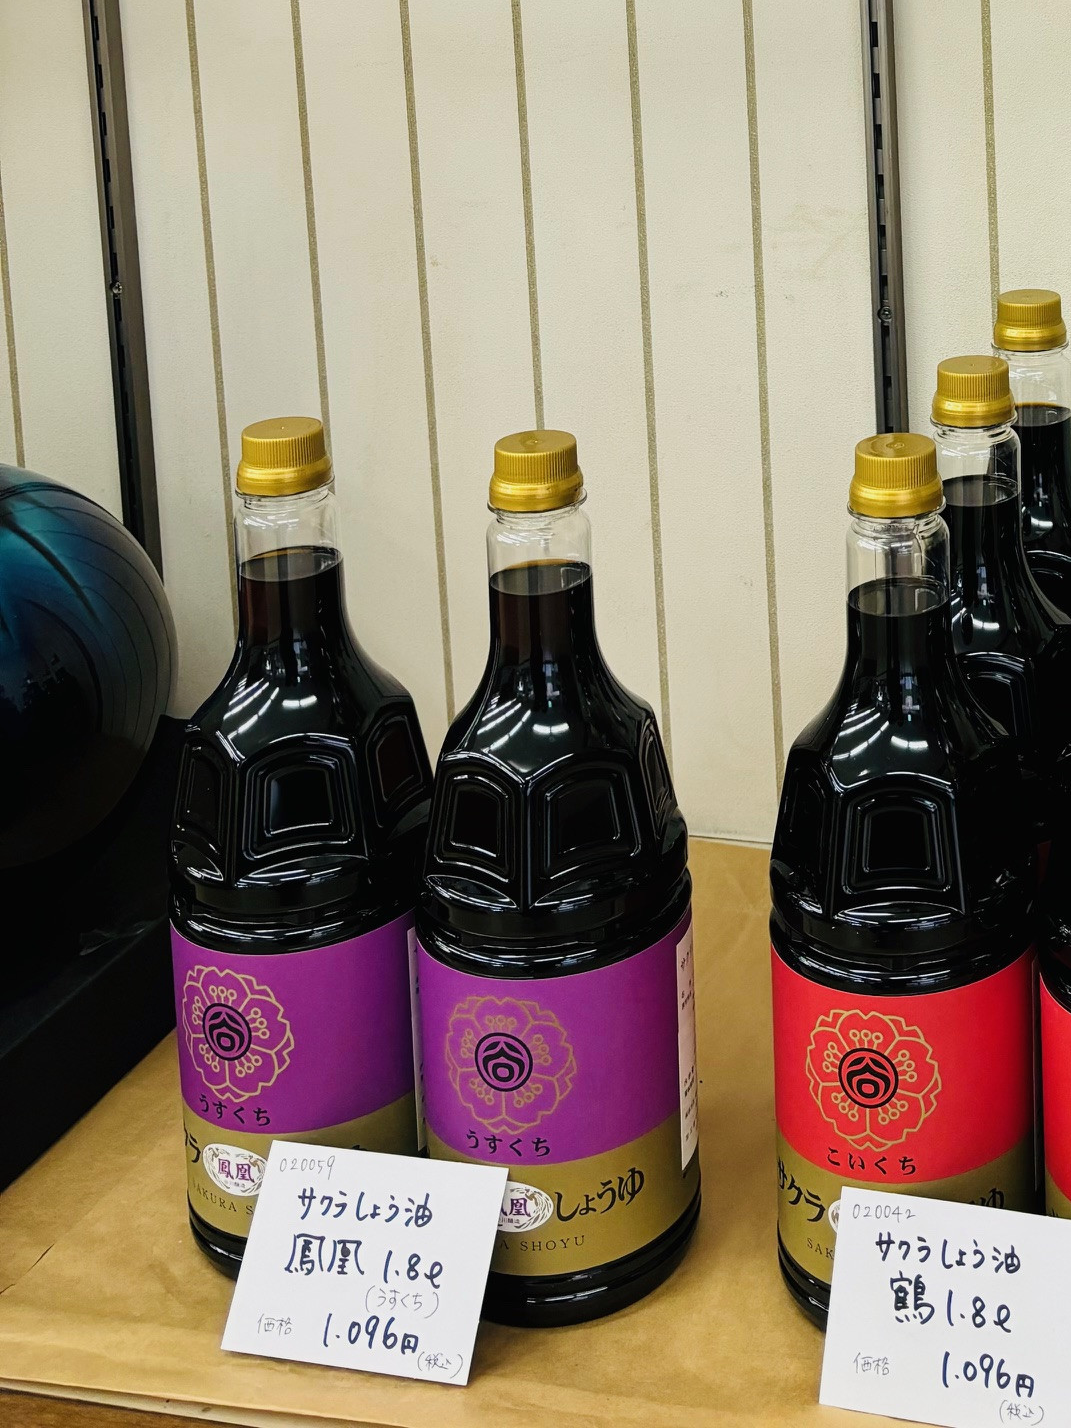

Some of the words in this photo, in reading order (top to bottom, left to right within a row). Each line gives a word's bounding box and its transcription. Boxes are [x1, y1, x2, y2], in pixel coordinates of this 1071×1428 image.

[199, 1094, 271, 1127] うすくち
[466, 1129, 551, 1158] うすくち
[218, 1158, 255, 1183] 鳳凰
[280, 1155, 336, 1180] 020059
[827, 1147, 917, 1176] こいくち
[555, 1167, 645, 1222] しょうゆ
[777, 1156, 826, 1223] サクラ
[297, 1186, 434, 1228] サクラしょう油
[500, 1197, 532, 1218] 凰
[852, 1203, 917, 1223] 020042
[284, 1233, 365, 1276] 鳳凰
[520, 1234, 586, 1253] SHOYU
[875, 1231, 1022, 1274] サクラしょう油
[257, 1313, 293, 1336] 価格
